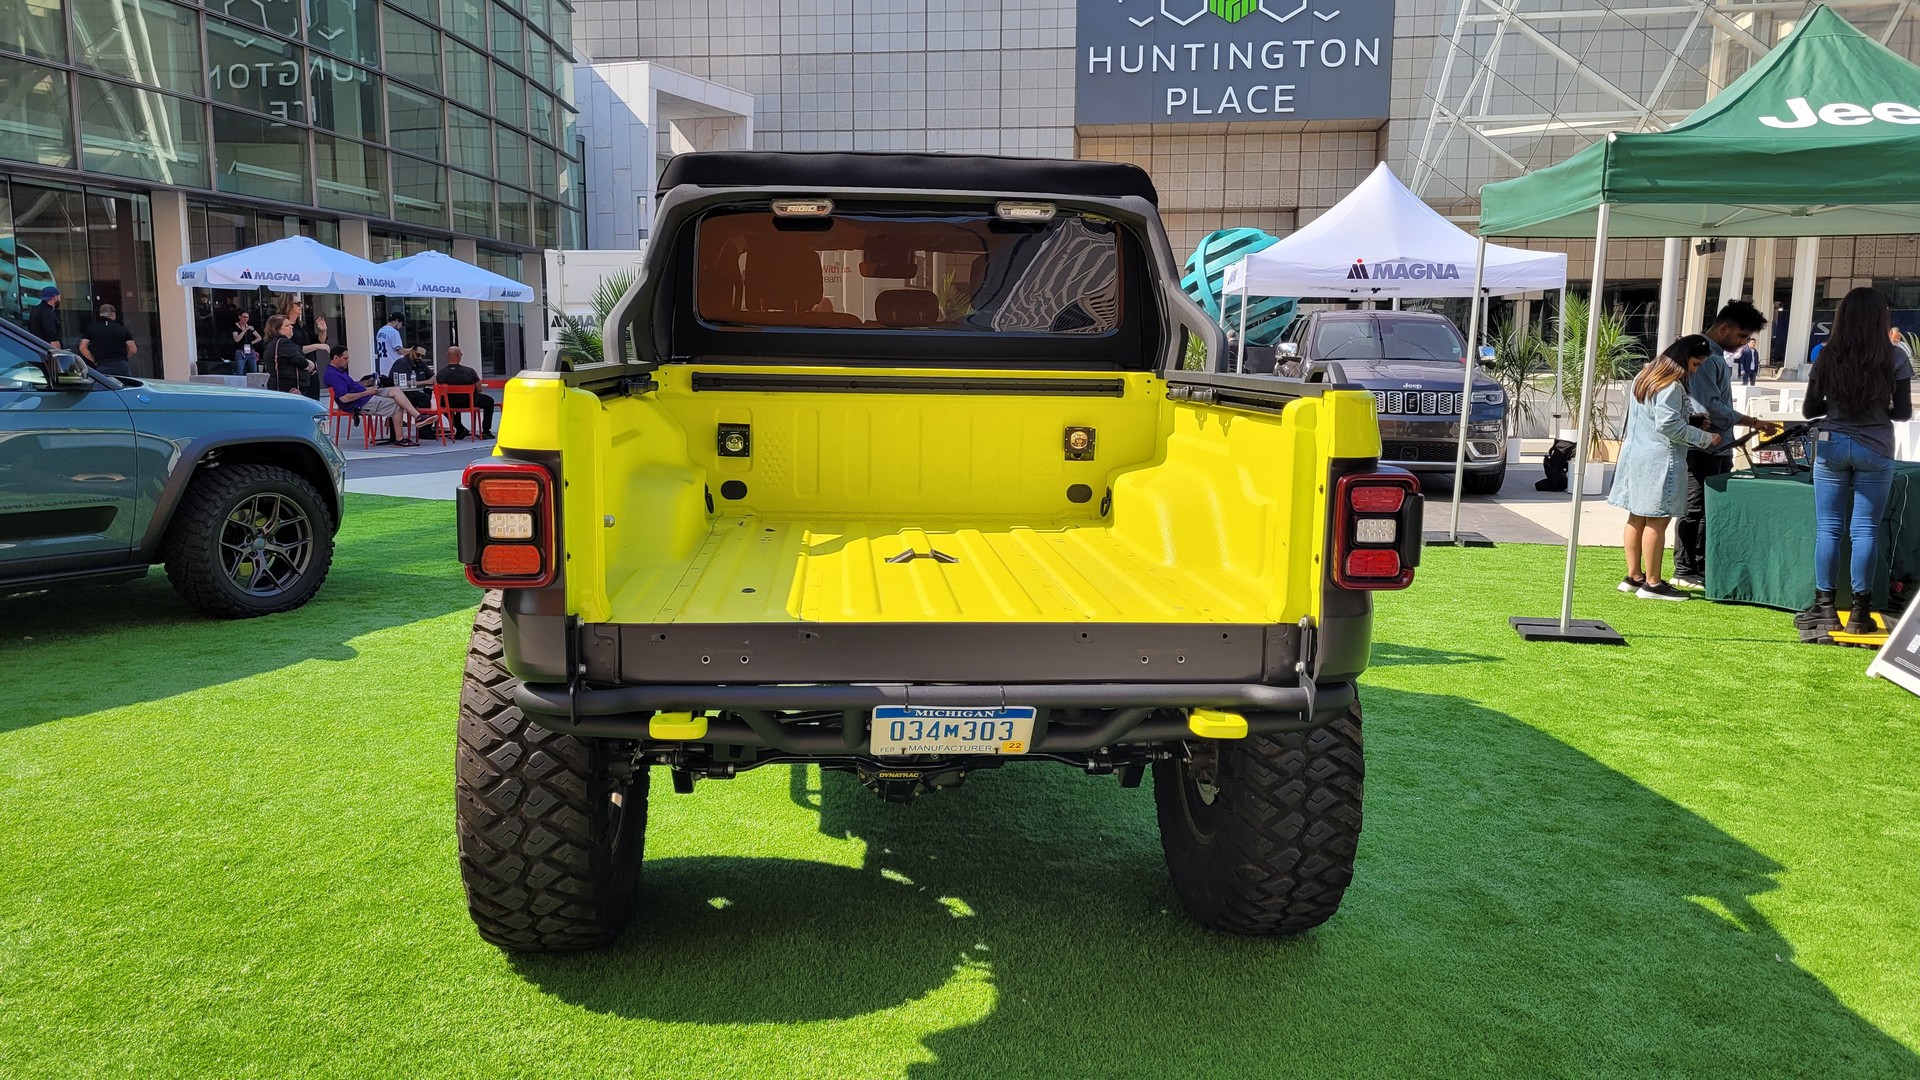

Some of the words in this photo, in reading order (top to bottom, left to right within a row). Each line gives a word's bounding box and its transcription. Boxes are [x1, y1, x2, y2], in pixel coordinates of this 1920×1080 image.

[1089, 38, 1379, 73] HUNTINGTON
[1167, 85, 1296, 115] PLACE
[1757, 97, 1920, 128] Jee
[254, 271, 301, 282] MAGNA
[1372, 263, 1460, 280] MAGNA
[366, 277, 396, 289] MAGNA
[421, 284, 462, 294] MAGNA
[1402, 382, 1422, 390] Jeep
[914, 710, 995, 718] MICHIGAN
[889, 720, 1014, 741] 034M303
[908, 744, 992, 752] MANUFACTURER
